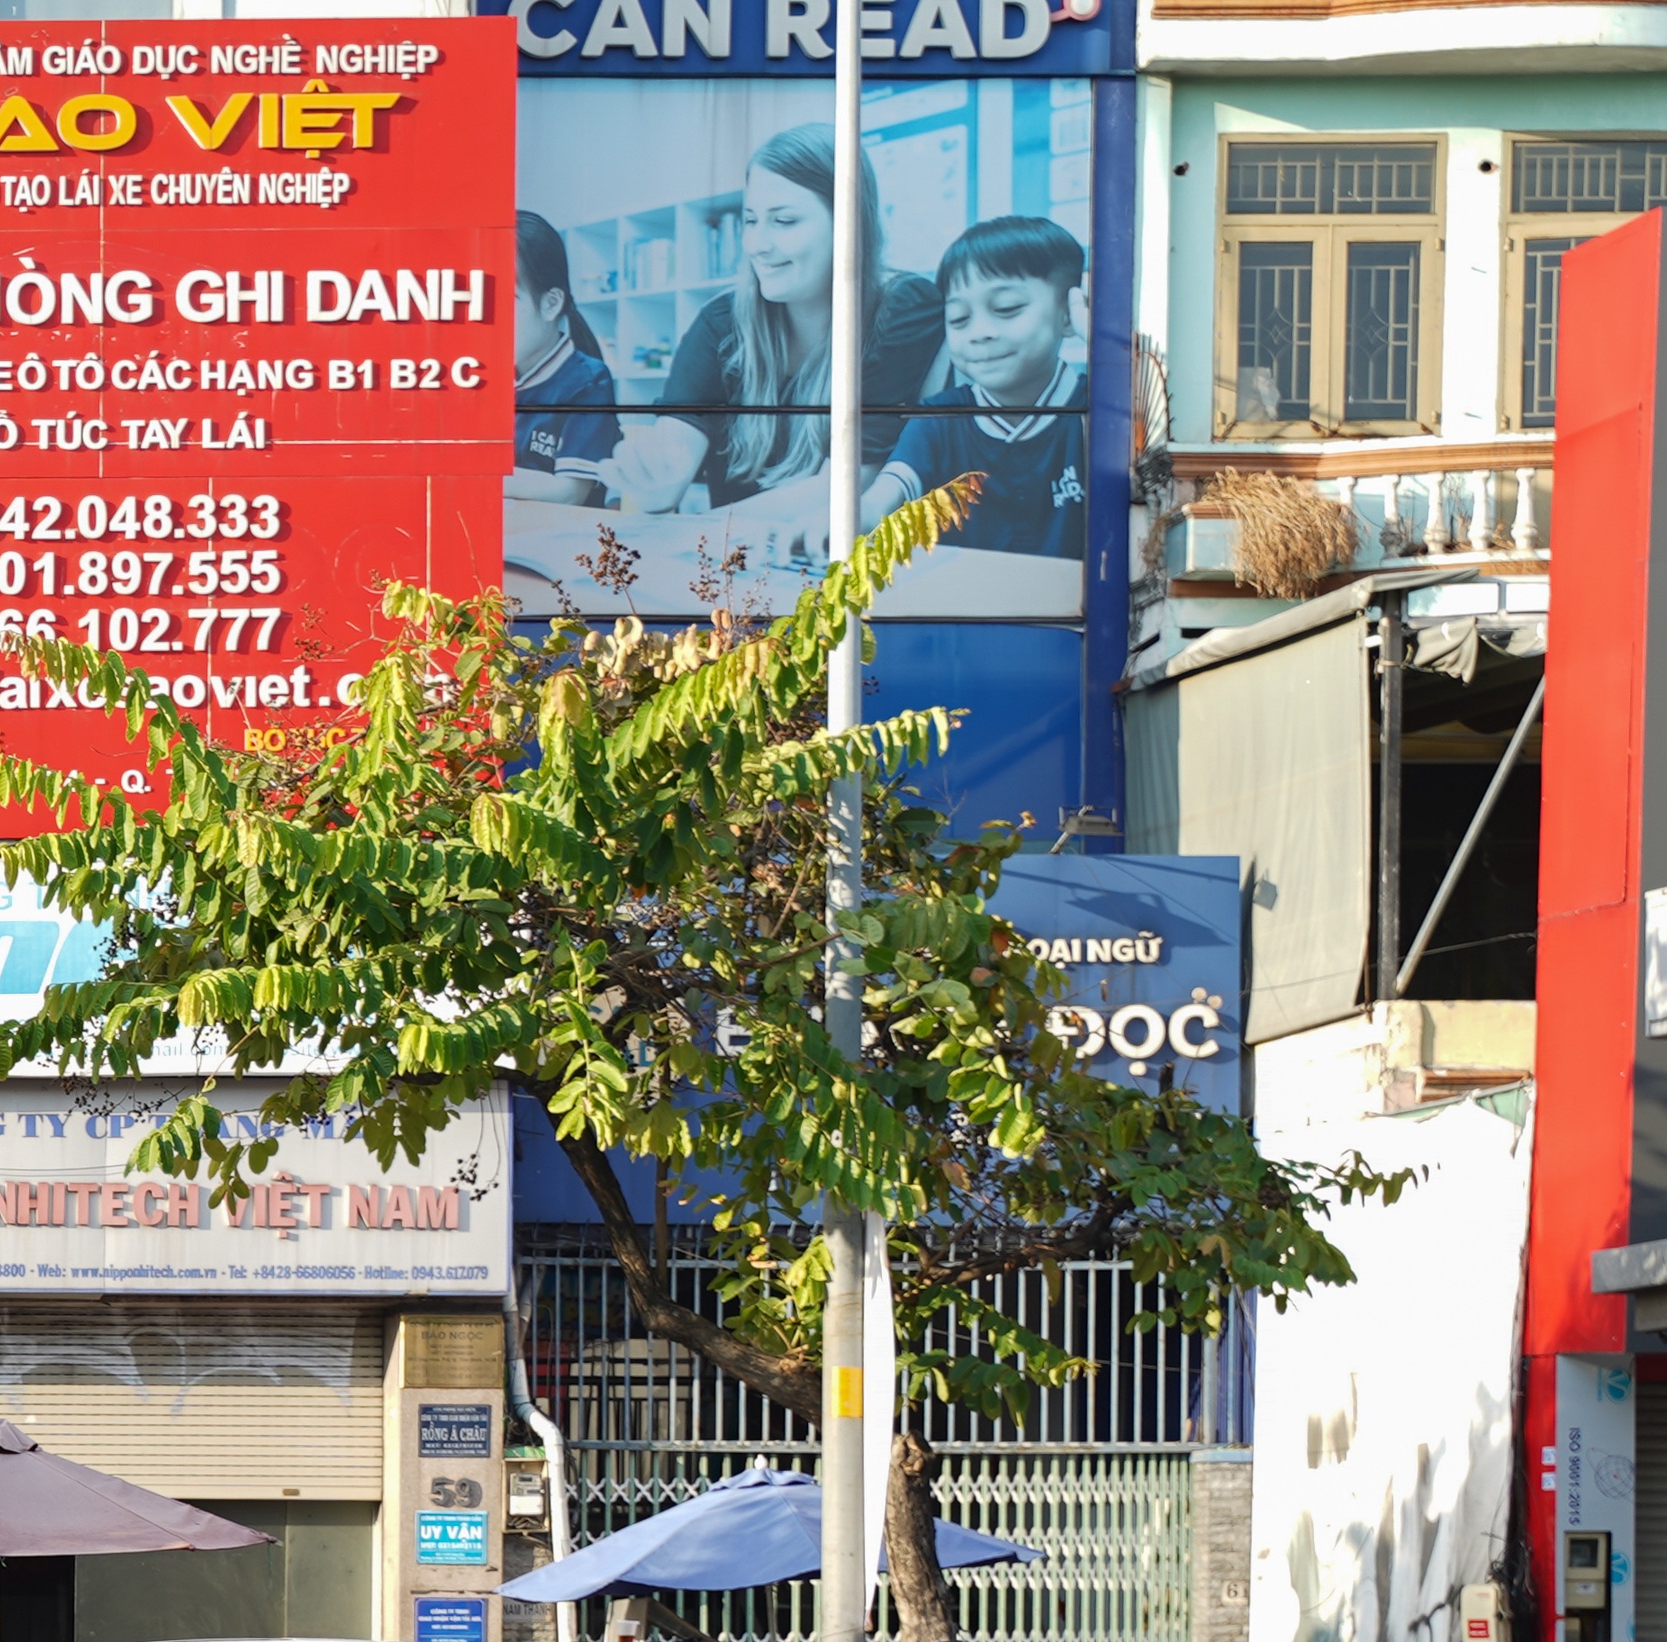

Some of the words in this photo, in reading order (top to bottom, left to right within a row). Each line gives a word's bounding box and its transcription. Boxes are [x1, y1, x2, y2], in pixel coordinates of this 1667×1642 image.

[516, 0, 731, 60] CAN
[766, 0, 1052, 59] READ
[42, 43, 121, 76] GIÁO
[132, 45, 198, 81] DỤC
[210, 33, 300, 76] NGHỀ
[314, 40, 439, 80] NGHIỆP
[167, 79, 407, 159] VIỆT
[0, 175, 51, 212] TẠO
[58, 168, 101, 206] LÁI
[108, 175, 143, 206] XE
[150, 169, 252, 206] CHUYÊN
[259, 168, 351, 210] NGHIỆP
[176, 269, 285, 325] GHI
[306, 269, 484, 324] DANH
[18, 351, 43, 391] Ô
[56, 351, 106, 391] TÔ
[115, 350, 193, 391] CÁC
[200, 359, 314, 396] HẠNG
[328, 359, 375, 389] B1
[391, 359, 441, 389] B2
[450, 357, 482, 388] C
[31, 414, 110, 452] TÚC
[121, 419, 188, 451] TAY
[201, 412, 266, 450] LÁI
[121, 770, 153, 793] Q.
[1087, 929, 1164, 963] NGỮ
[1046, 1004, 1219, 1076] ĐỌC
[19, 1112, 67, 1139] TY
[86, 1113, 134, 1140] CP
[224, 1171, 332, 1239] VIỆT
[347, 1184, 460, 1232] NAM
[38, 1264, 67, 1278] Web:
[71, 1265, 217, 1282] www.nipponhitech.com.vn
[252, 1266, 356, 1281] +8428-66806056
[430, 1476, 483, 1508] 59
[421, 1525, 442, 1540] UY
